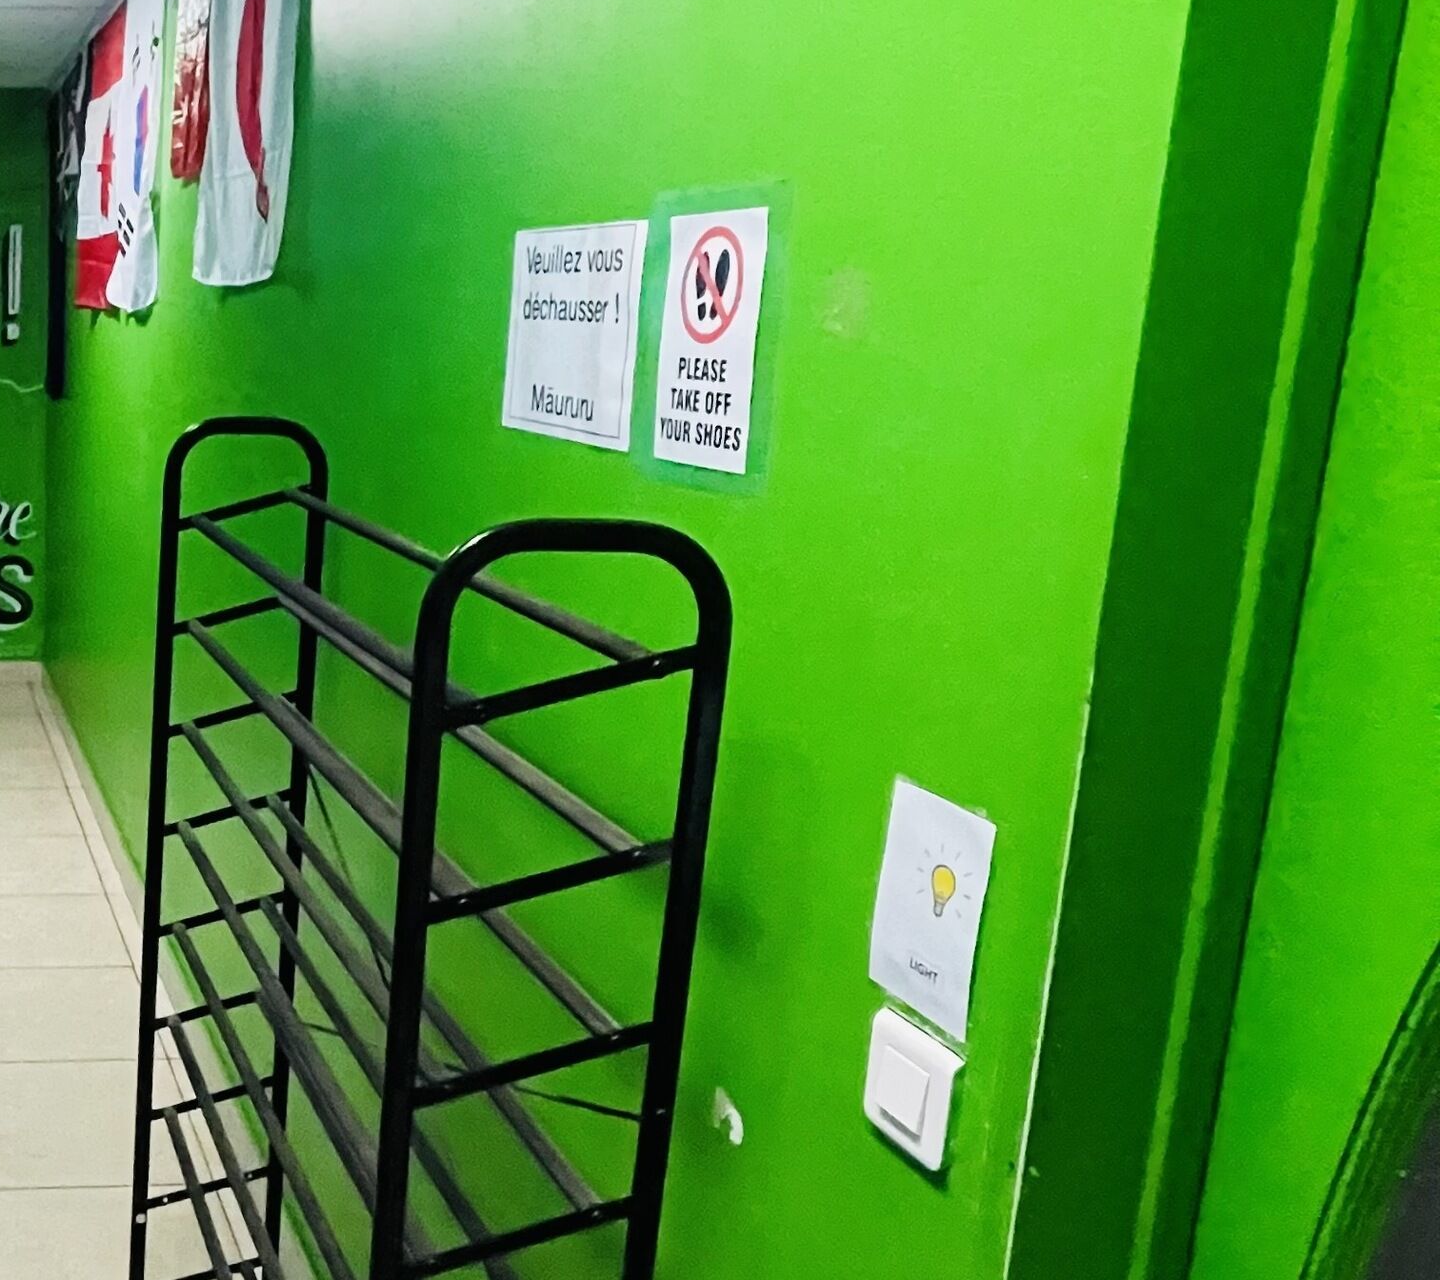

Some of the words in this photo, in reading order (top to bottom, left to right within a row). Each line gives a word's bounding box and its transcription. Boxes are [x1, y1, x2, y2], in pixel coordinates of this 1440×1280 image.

[526, 245, 582, 274] Veuillez
[587, 248, 624, 272] vous
[523, 292, 608, 322] déchausser
[678, 357, 727, 382] PLEASE
[531, 384, 594, 421] Māururu
[671, 388, 700, 412] TAKE
[705, 391, 732, 416] OFF
[660, 417, 691, 443] YOUR
[694, 422, 742, 452] SHOES
[909, 956, 938, 985] LIGHT
